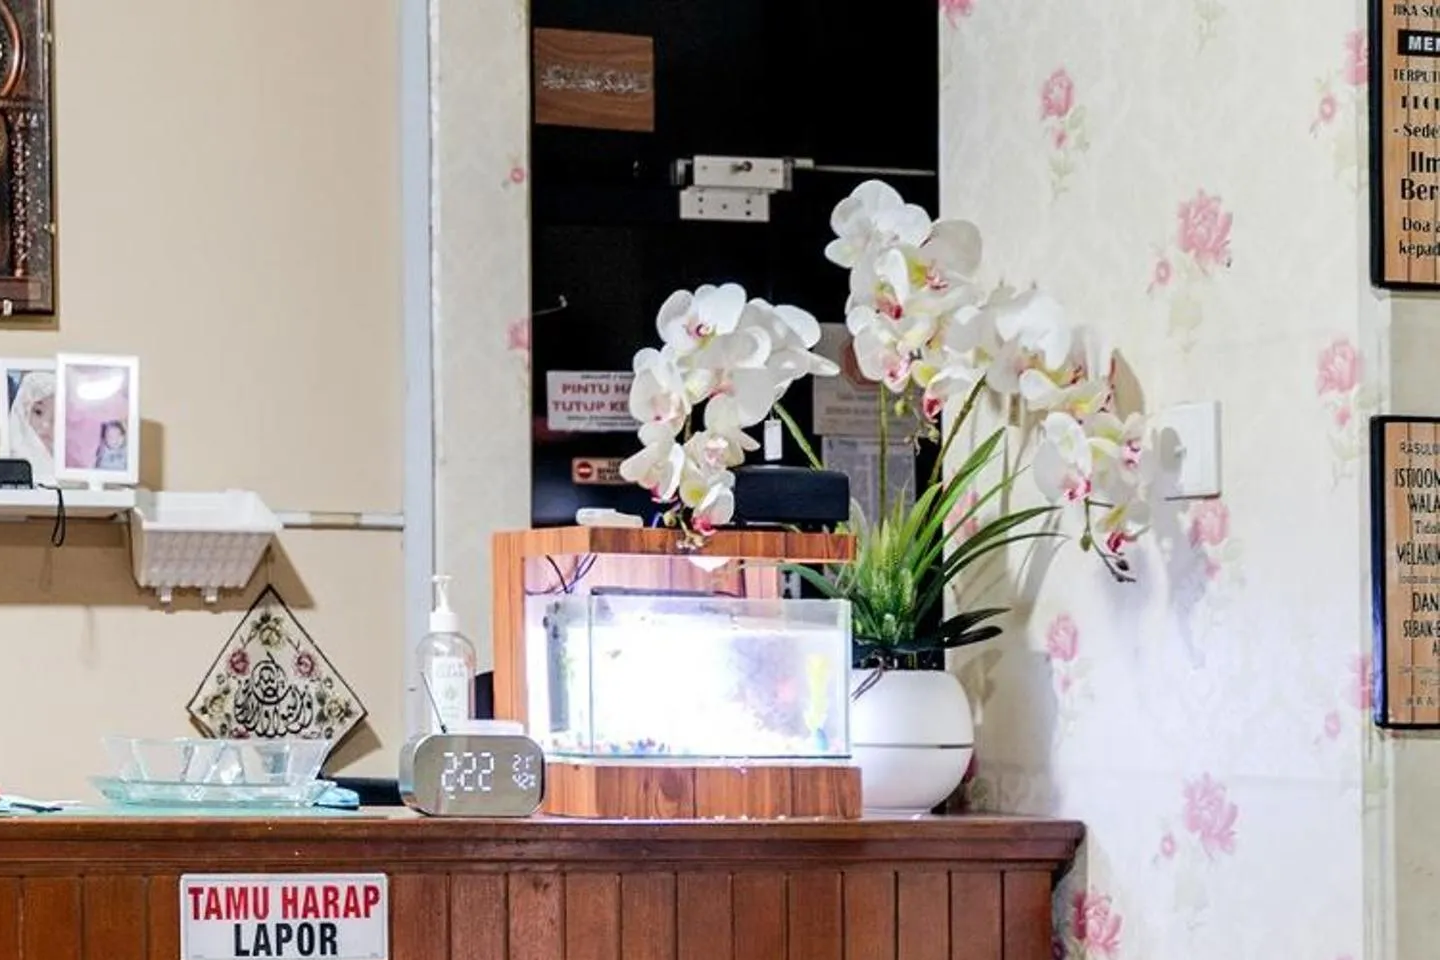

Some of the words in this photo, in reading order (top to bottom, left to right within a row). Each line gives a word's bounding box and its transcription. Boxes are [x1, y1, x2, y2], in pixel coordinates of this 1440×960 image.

[562, 383, 610, 394] PINTU
[553, 401, 606, 412] TUTUP
[188, 886, 269, 921] TAMU
[282, 885, 381, 920] HARAP
[234, 922, 338, 957] LAPOR
